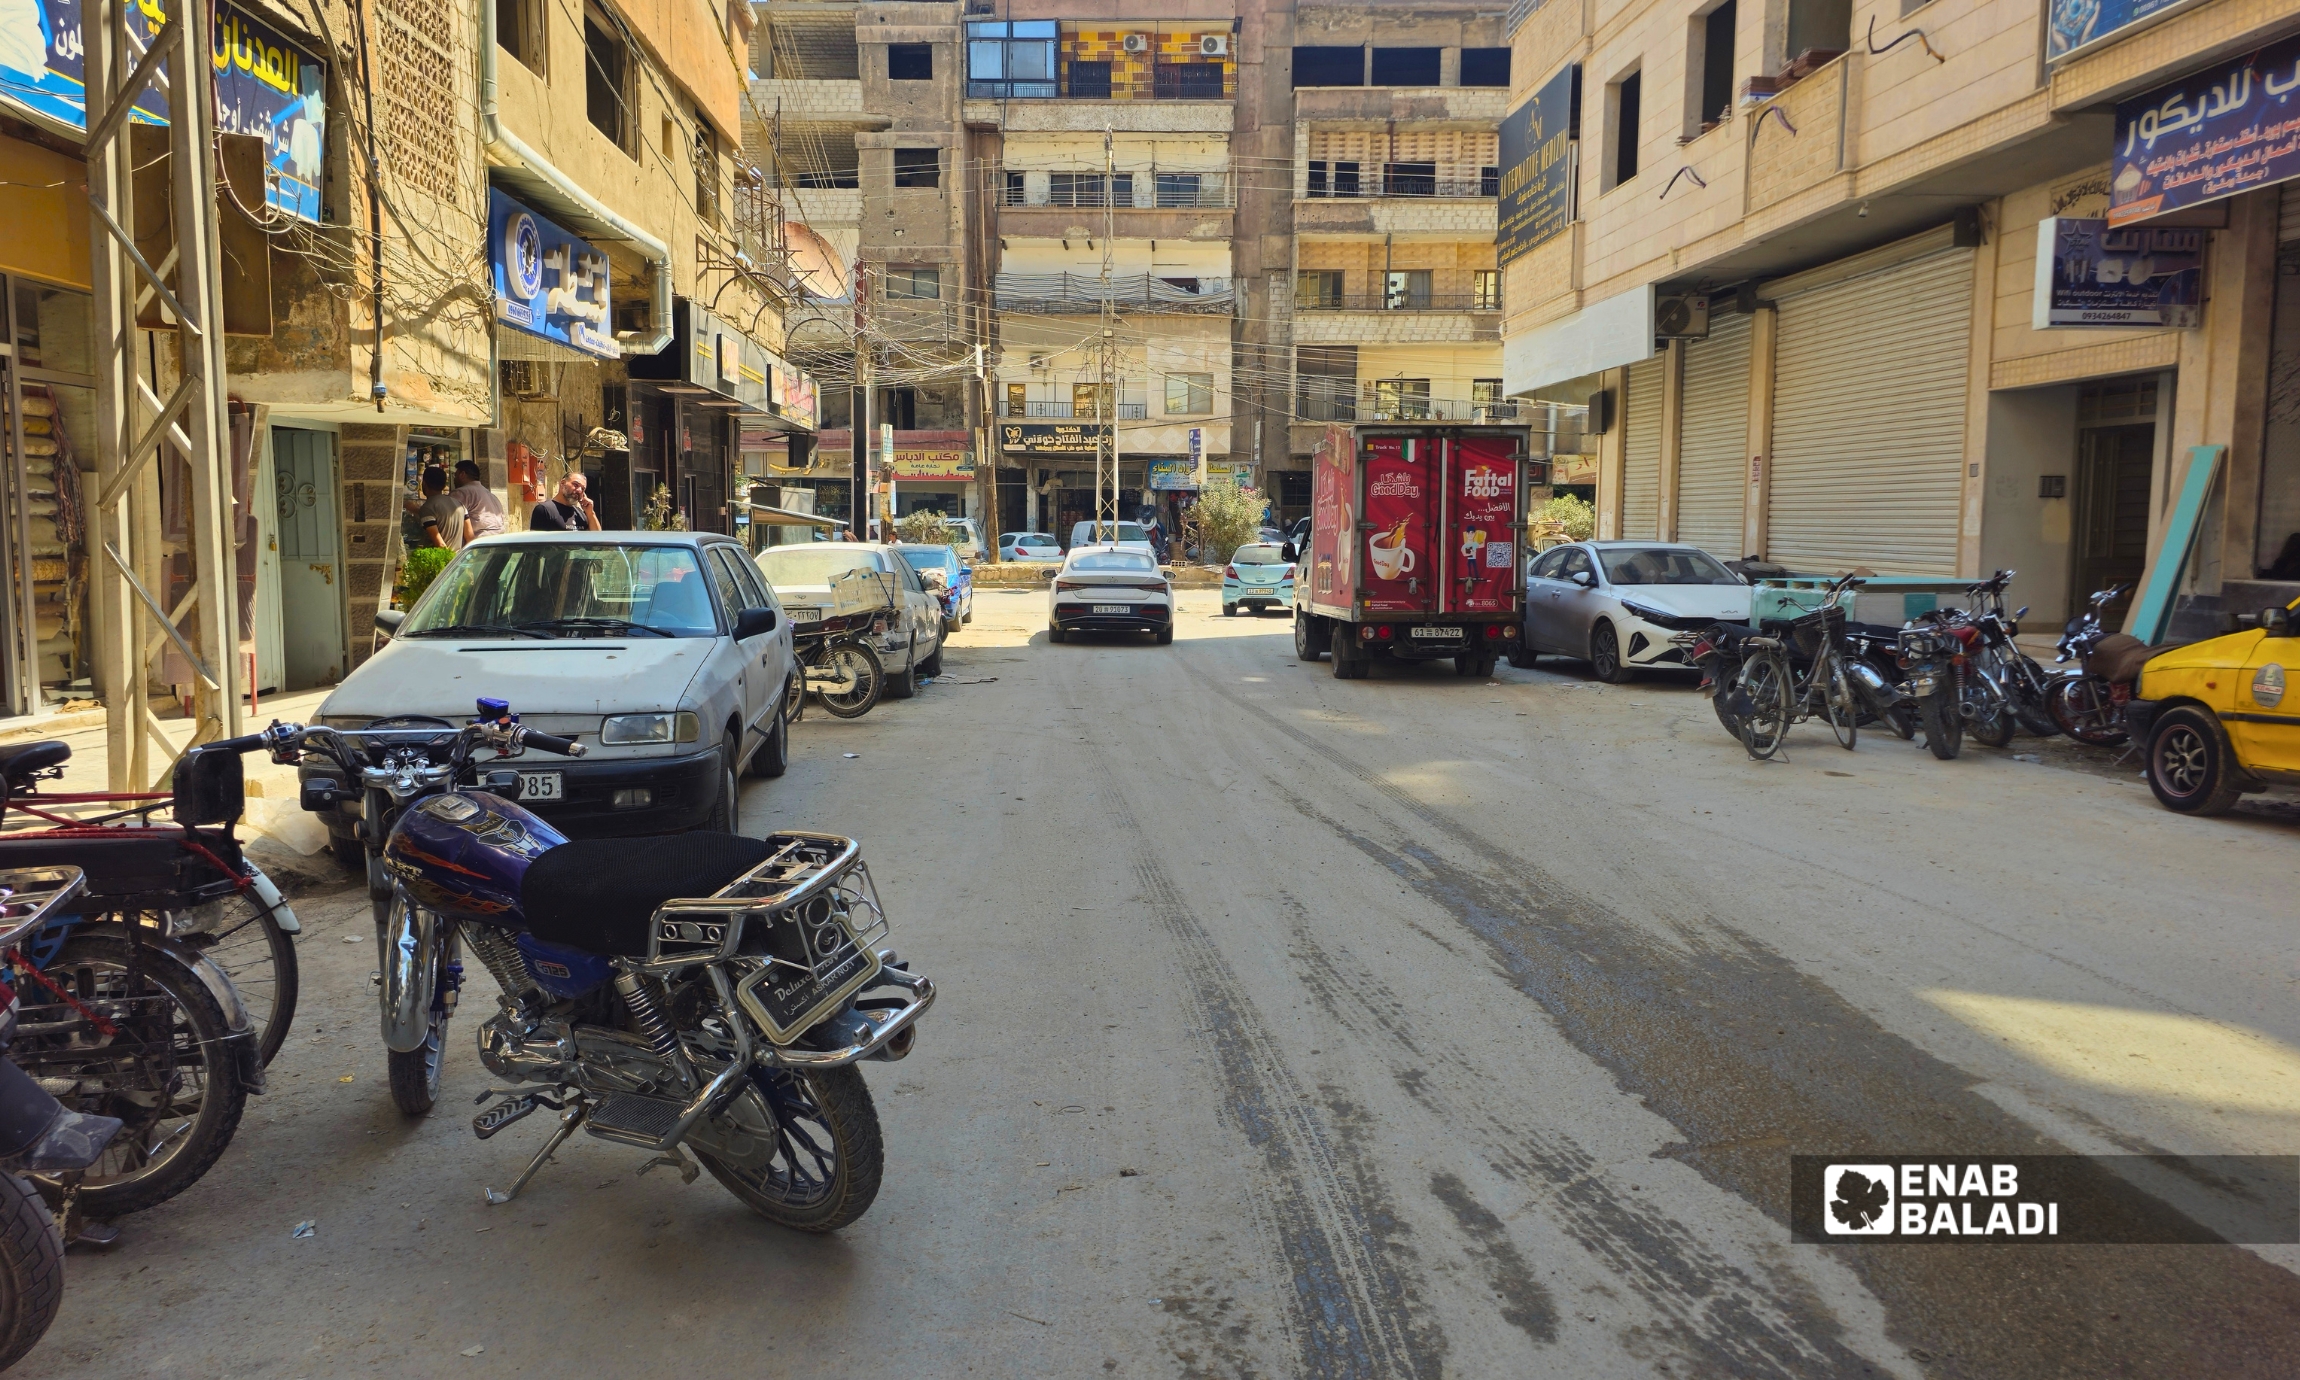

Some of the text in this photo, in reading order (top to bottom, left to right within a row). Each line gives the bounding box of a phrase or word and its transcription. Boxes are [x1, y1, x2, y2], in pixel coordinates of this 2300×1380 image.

[2123, 67, 2251, 158] للديكور
[1500, 150, 1539, 202] ALTERNATIVE
[1540, 128, 1567, 173] MEDIZIN
[2056, 289, 2072, 297] Wifi
[2072, 289, 2103, 297] outdoor
[2082, 312, 2132, 320] 0934264847
[1055, 434, 1082, 446] الفتاح
[928, 452, 960, 463] مكتب
[1152, 462, 1177, 475] البناء
[1465, 468, 1512, 487] Fattal
[1464, 486, 1500, 497] FOOD
[1414, 628, 1424, 637] 61
[1435, 628, 1460, 637] 87422
[812, 973, 838, 996] ASKAR
[836, 961, 855, 981] NO.1
